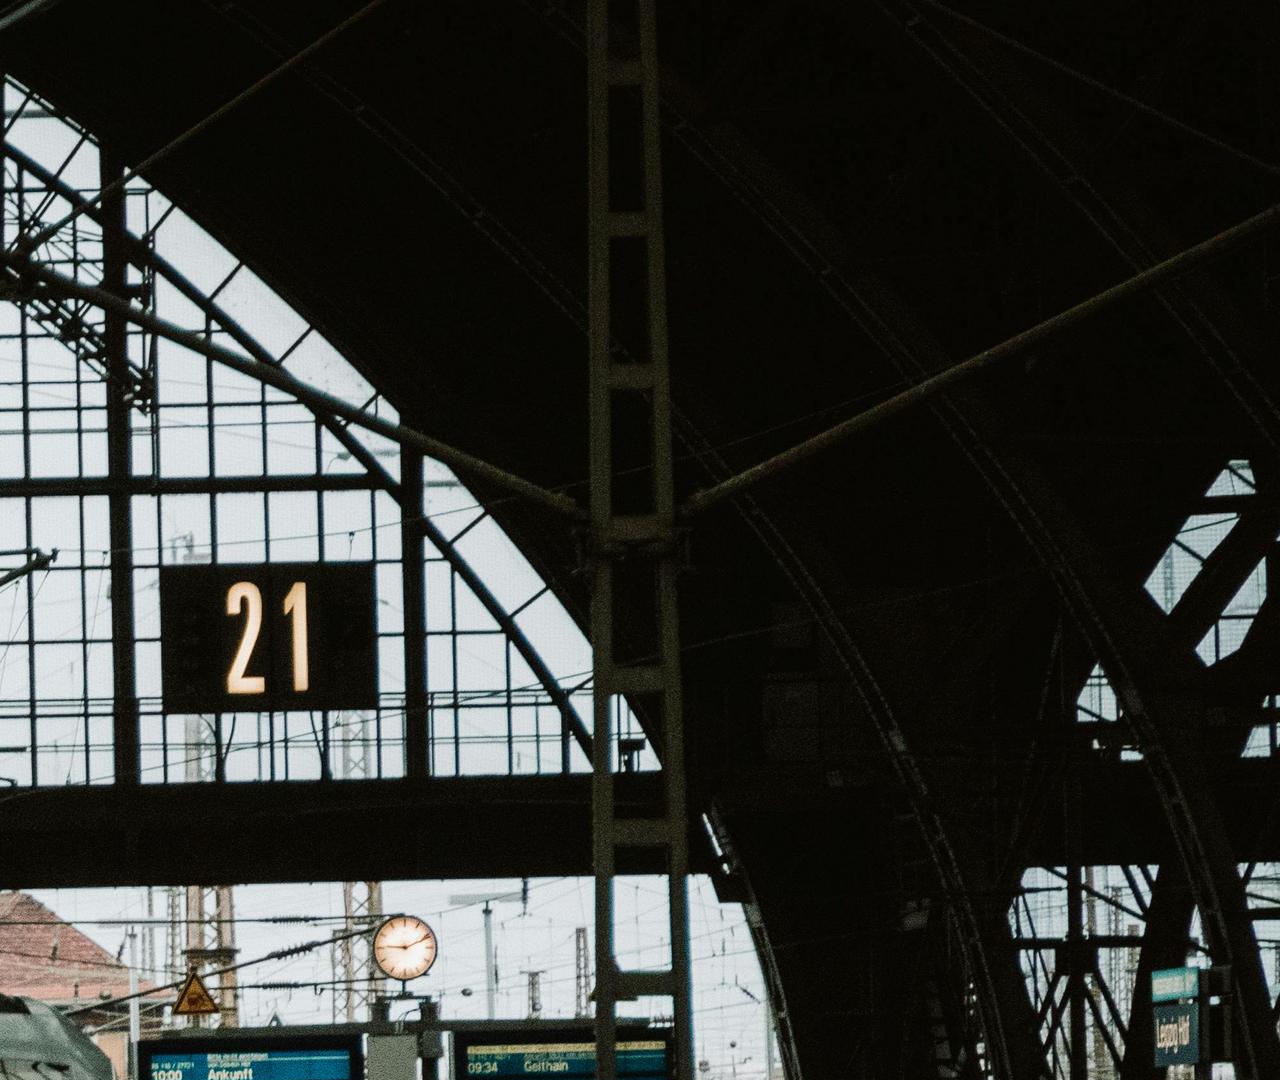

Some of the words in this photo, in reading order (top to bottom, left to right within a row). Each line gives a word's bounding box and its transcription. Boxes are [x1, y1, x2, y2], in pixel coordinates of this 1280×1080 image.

[226, 581, 309, 694] 21
[468, 1062, 498, 1074] 09:34
[524, 1060, 569, 1073] Geithain
[207, 1068, 253, 1080] Ankunft
